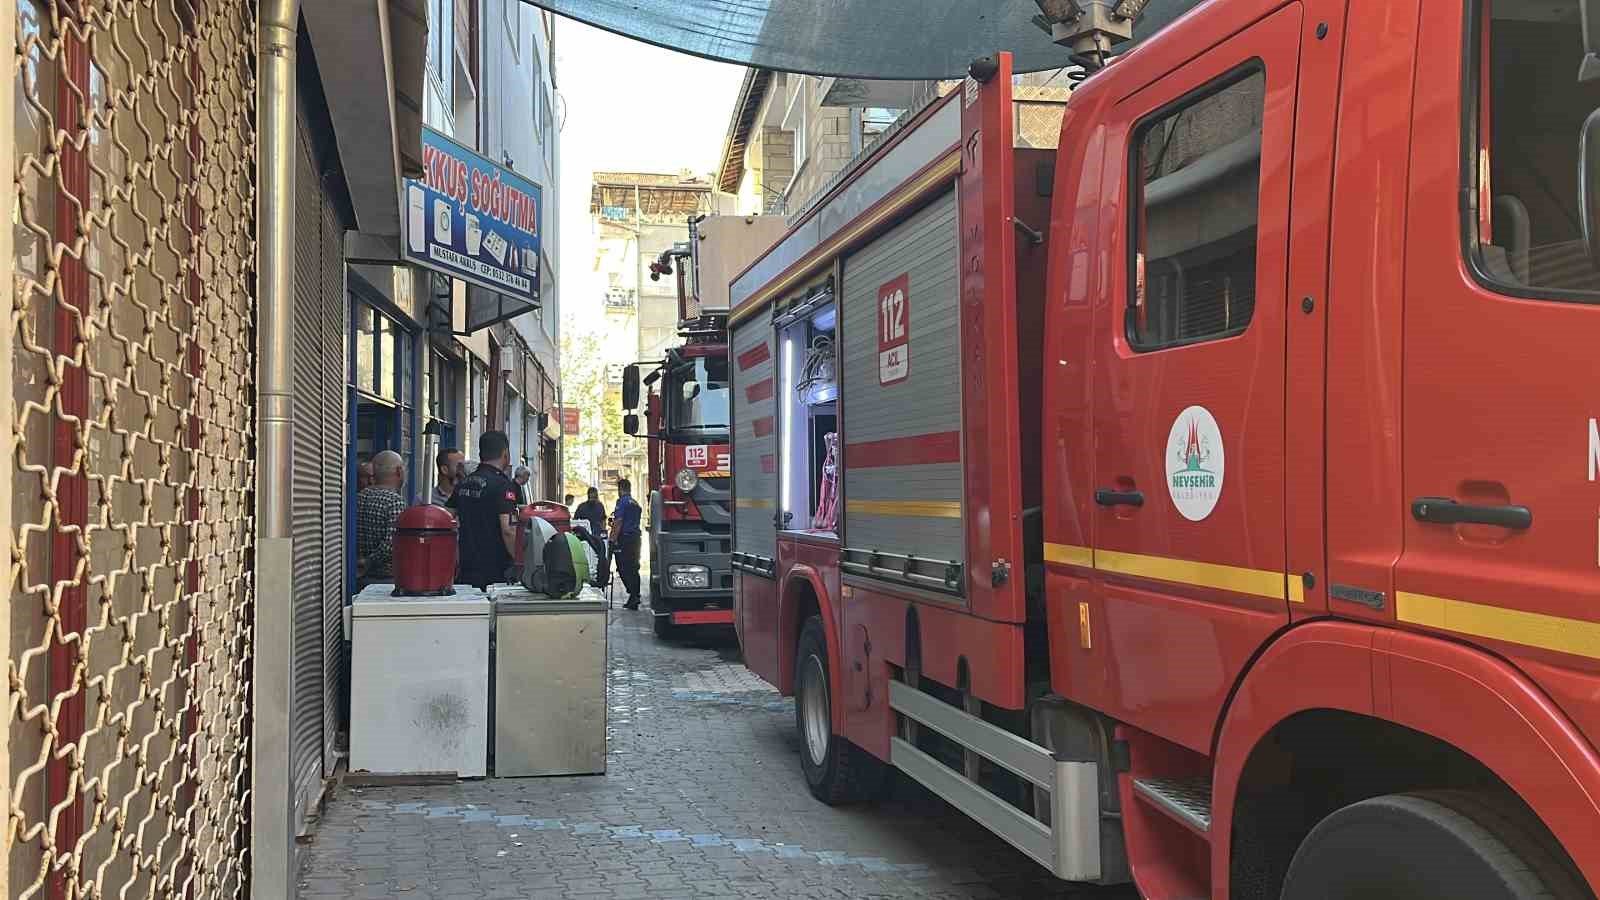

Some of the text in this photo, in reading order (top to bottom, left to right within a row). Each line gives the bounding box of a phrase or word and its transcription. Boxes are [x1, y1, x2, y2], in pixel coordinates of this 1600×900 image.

[421, 143, 537, 237] KKUŞ SOĞUTMA
[882, 288, 904, 342] 112
[689, 448, 705, 458] 112
